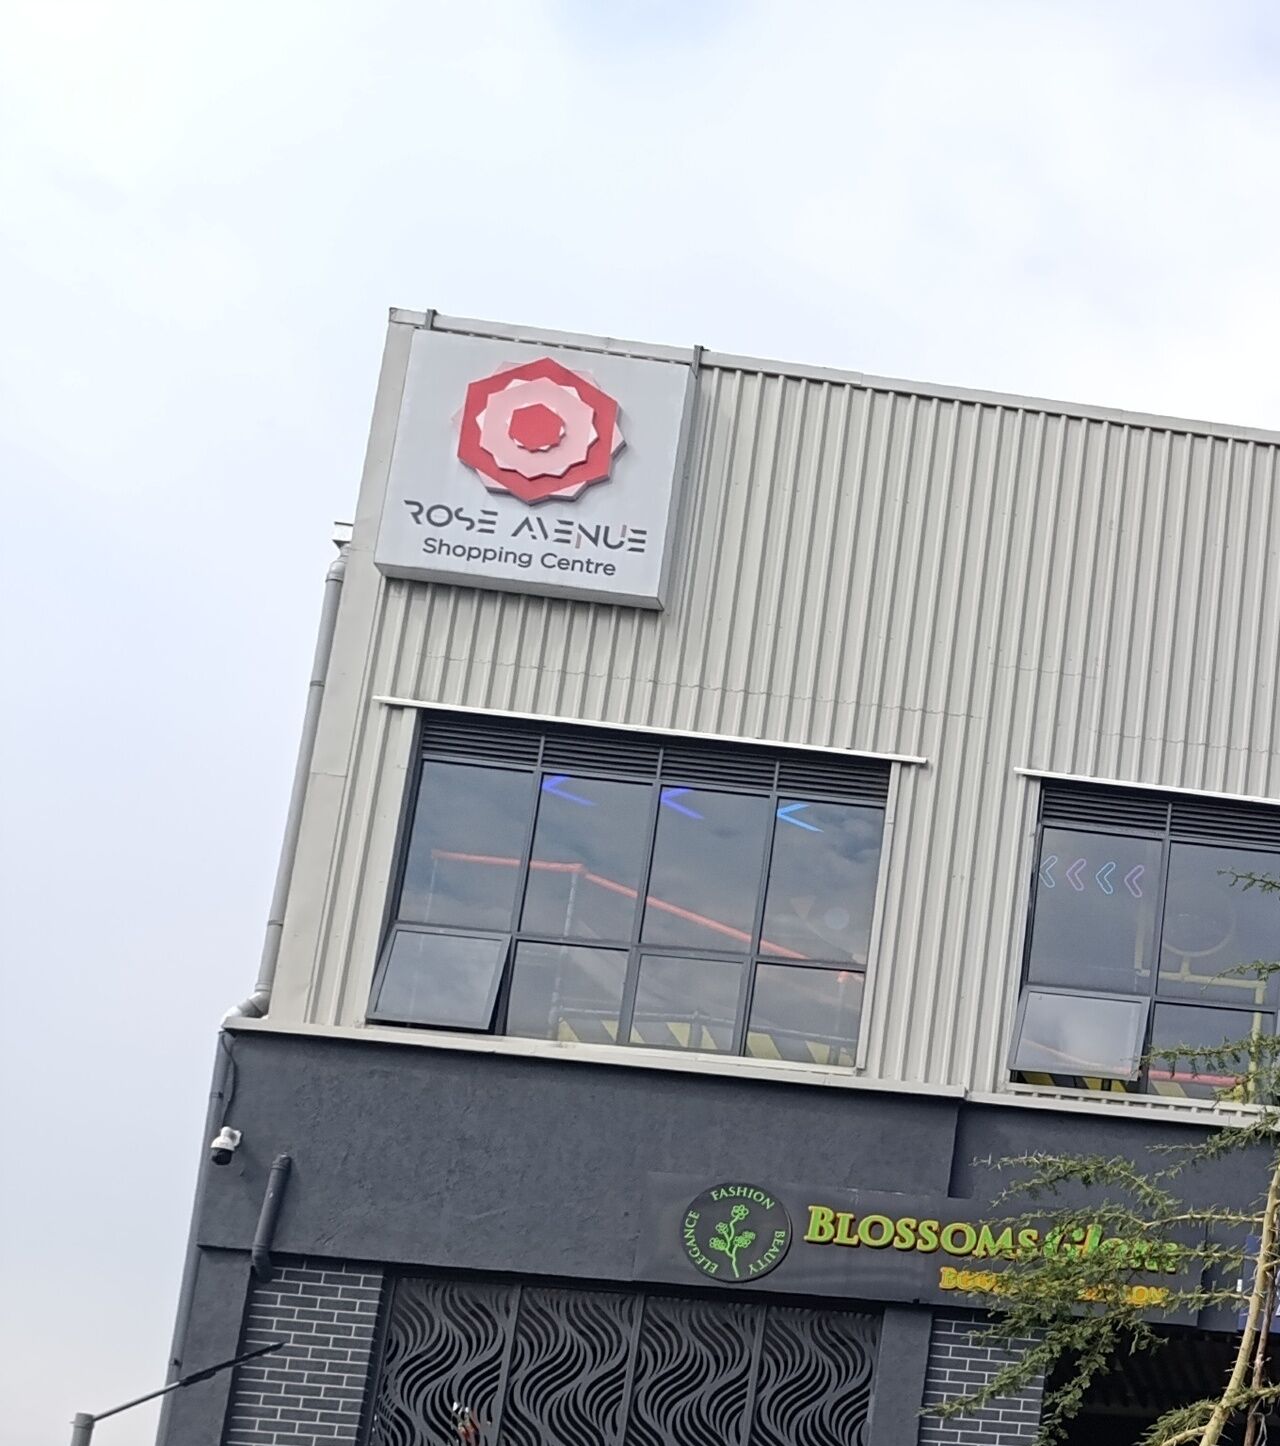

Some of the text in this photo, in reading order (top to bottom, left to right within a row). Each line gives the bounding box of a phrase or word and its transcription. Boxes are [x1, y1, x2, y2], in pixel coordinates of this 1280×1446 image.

[404, 500, 498, 534] ROSE
[422, 537, 616, 576] Shopping Centre
[710, 1186, 775, 1210] FASHION
[684, 1210, 719, 1274] ELEGANCE
[749, 1230, 786, 1275] BEAUTY
[804, 1205, 1040, 1260] BLOSSOMS
